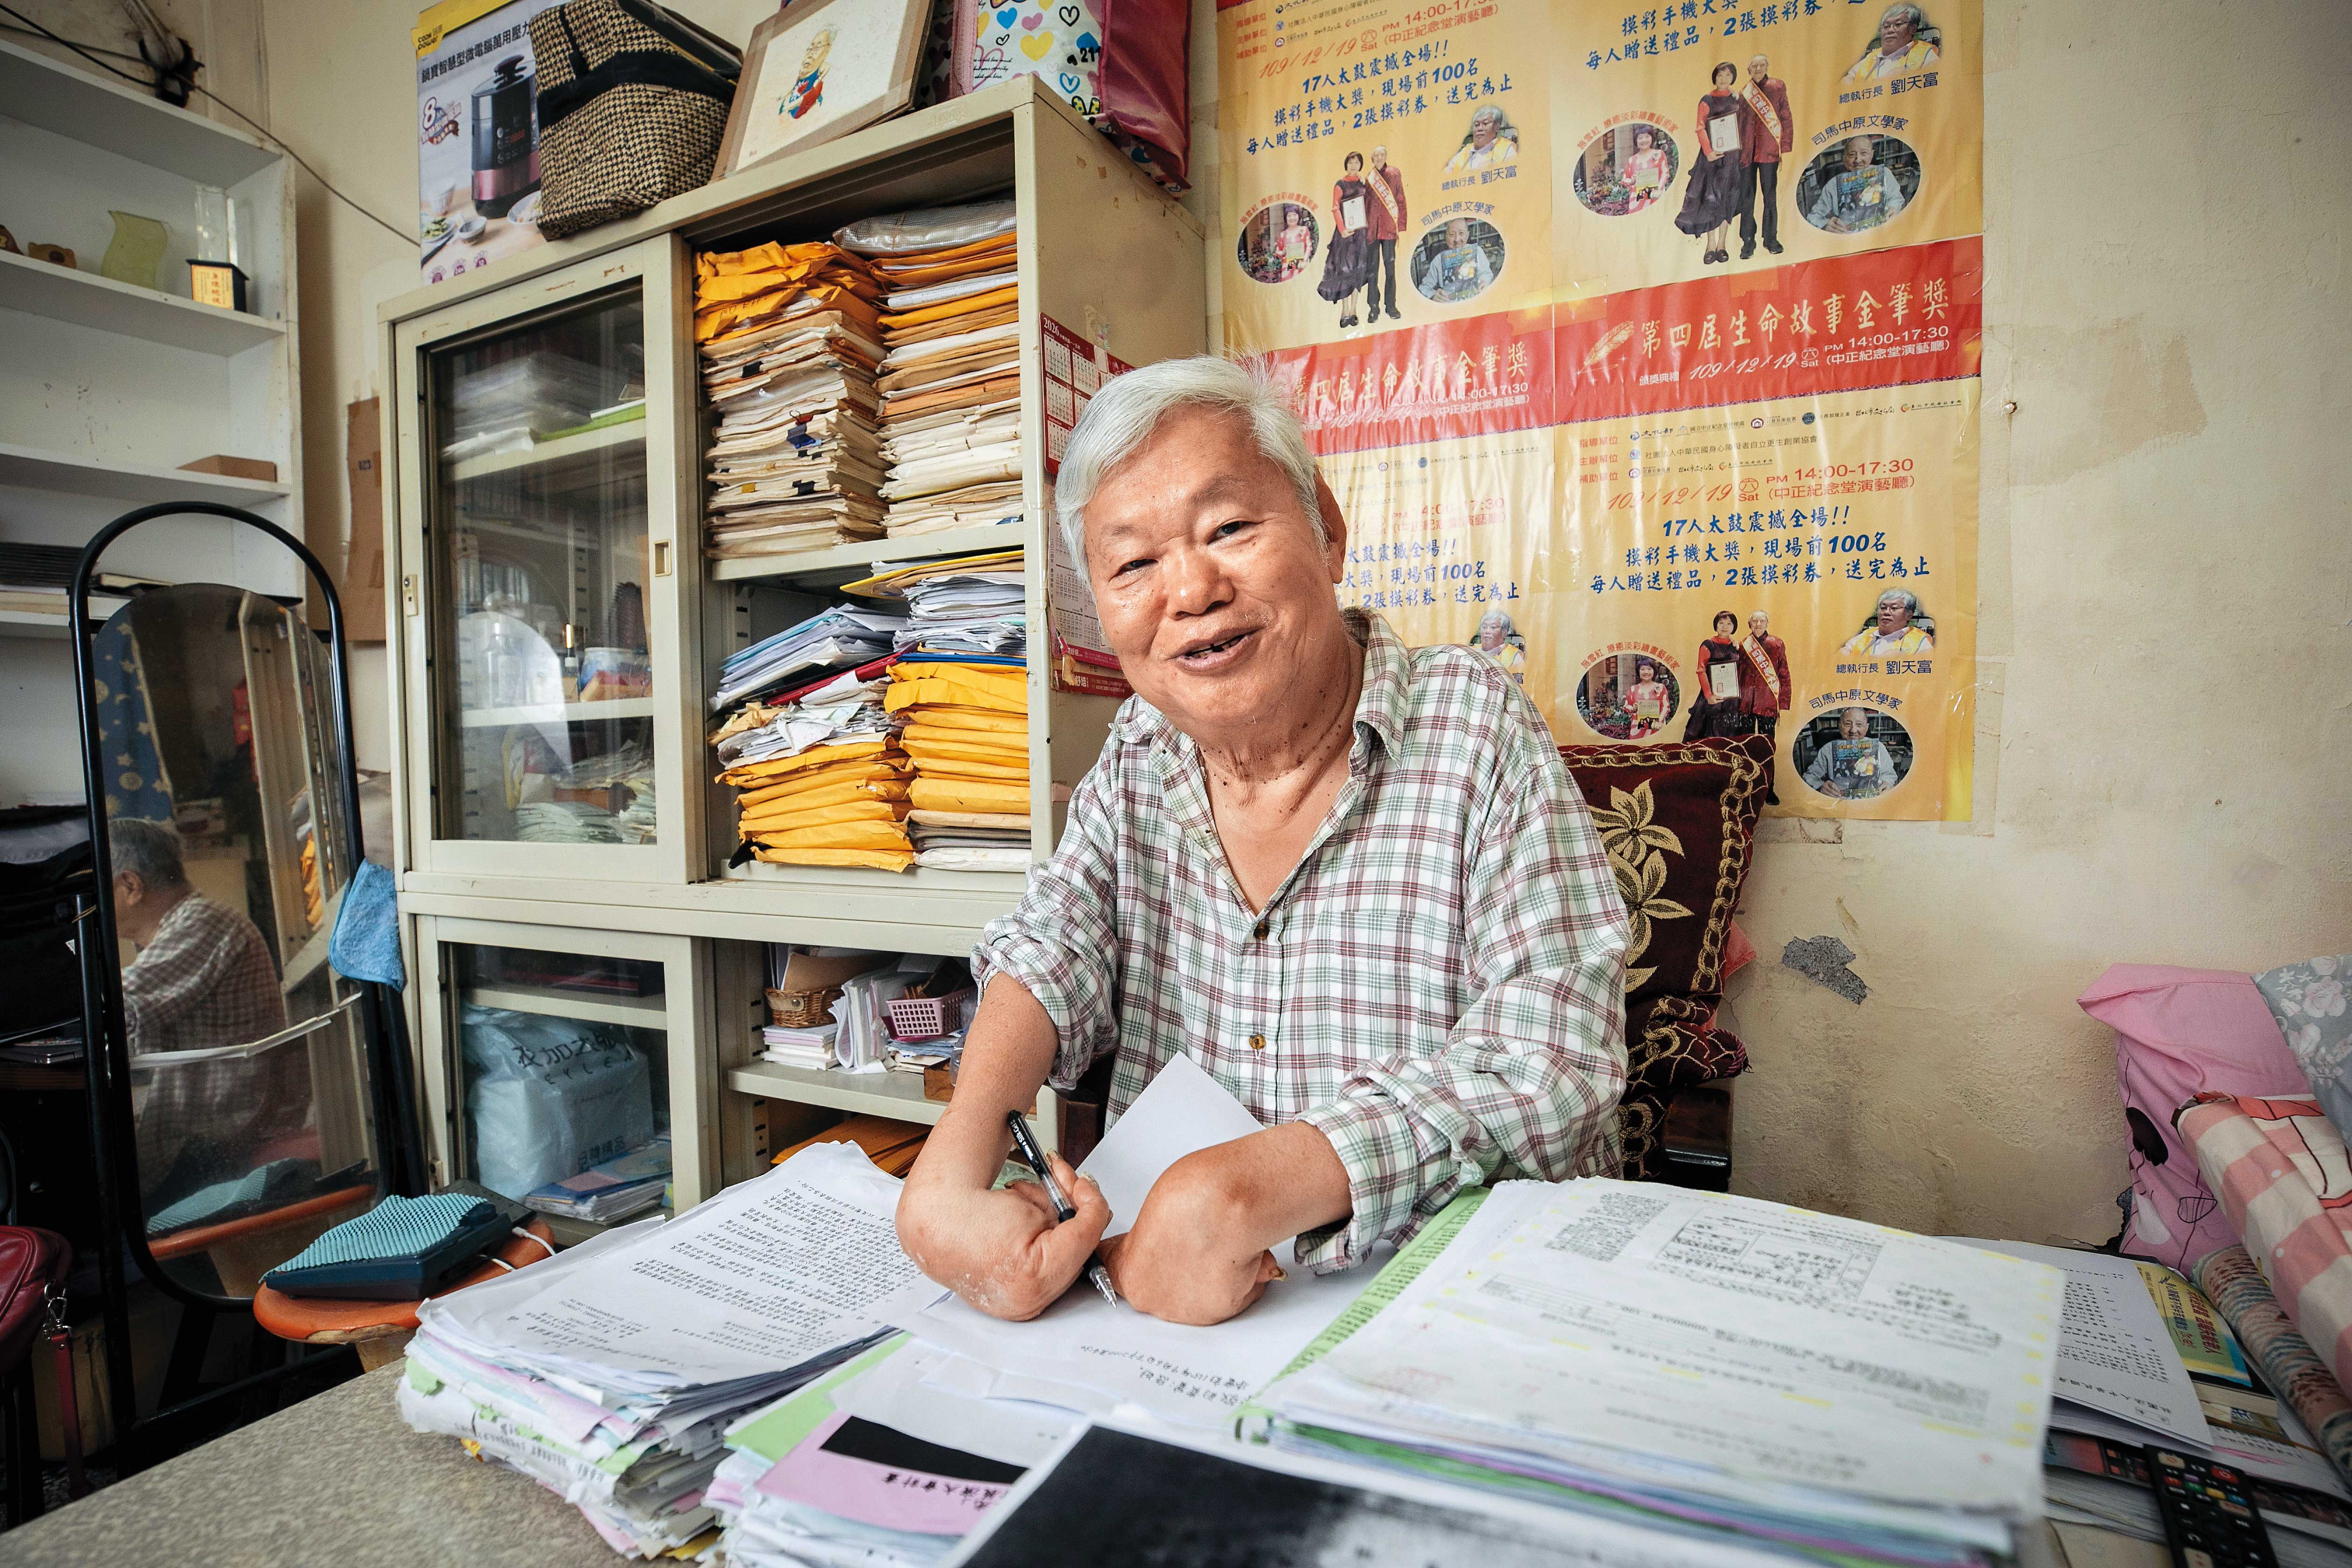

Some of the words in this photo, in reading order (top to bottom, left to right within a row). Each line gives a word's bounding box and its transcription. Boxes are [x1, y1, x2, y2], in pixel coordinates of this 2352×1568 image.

[1382, 22, 1400, 32] PM
[1361, 42, 1378, 52] Sat
[1839, 84, 1883, 104] 總執行長
[1890, 72, 1939, 94] 劉天富
[1811, 114, 1908, 146] 司馬中原文學家
[1442, 175, 1476, 191] 總執行長
[1481, 165, 1517, 185] 劉天富
[1421, 201, 1495, 226] 司馬中原文學家
[1044, 317, 1059, 336] 2026
[1641, 278, 1948, 358] 第四屆生命故事金筆獎
[1848, 325, 1949, 348] 14:00-17:30
[1689, 352, 1797, 380] 109/12/19
[1801, 359, 1819, 368] Sat
[1579, 435, 1618, 448] 指導單位
[1580, 454, 1618, 466] 主辦單位
[1767, 475, 1788, 484] PM
[1795, 458, 1914, 481] 14:00-17:30
[1608, 483, 1733, 510] 109/12/19
[1739, 492, 1759, 502] Sat
[1769, 475, 1915, 500] （中正紀念堂演藝廳）
[1663, 505, 1850, 537] 17人太鼓震撼全場!!
[1626, 531, 1887, 567] 摸彩手機大獎，現場前100名
[1335, 560, 1486, 588] 大獎，現場前100名
[1590, 556, 1930, 594] 每人贈送禮品，2張摸彩券，送完為止
[1836, 663, 1879, 674] 總執行長
[1886, 659, 1932, 675] 劉天富
[1809, 689, 1903, 710] 司馬中原文學家
